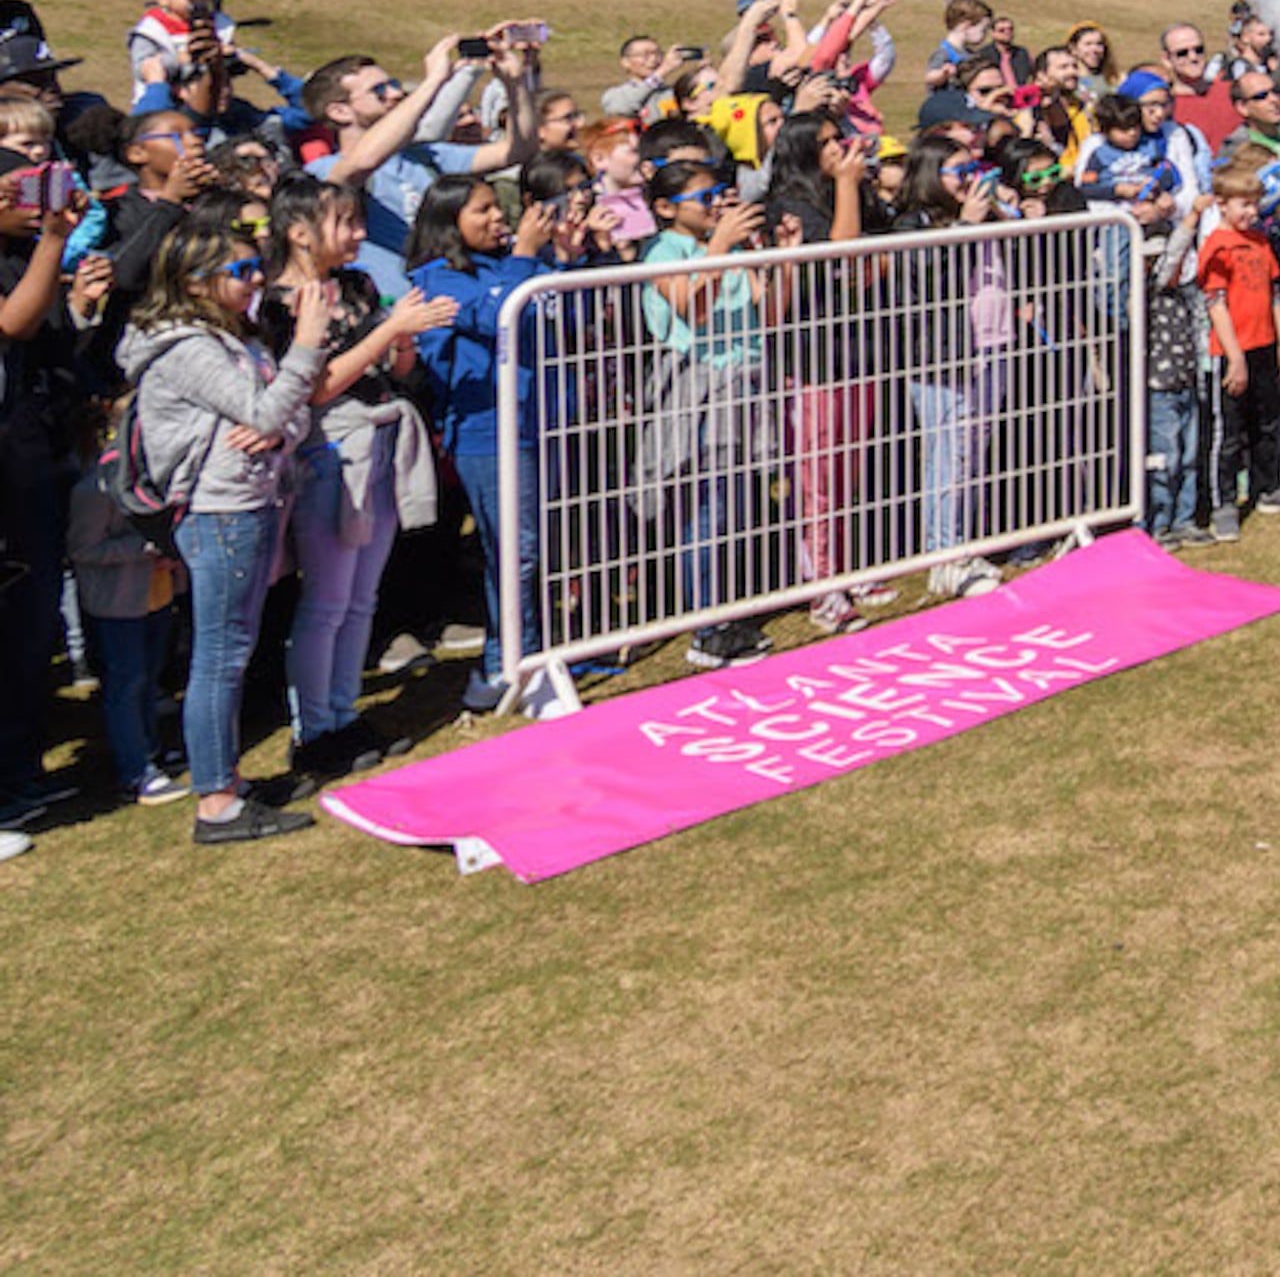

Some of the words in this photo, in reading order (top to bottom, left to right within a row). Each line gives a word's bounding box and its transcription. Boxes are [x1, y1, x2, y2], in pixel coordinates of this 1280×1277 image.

[638, 633, 987, 747] ATLANTA
[680, 624, 1094, 763] SCIENCE
[745, 657, 1119, 784] FESTIVAL
